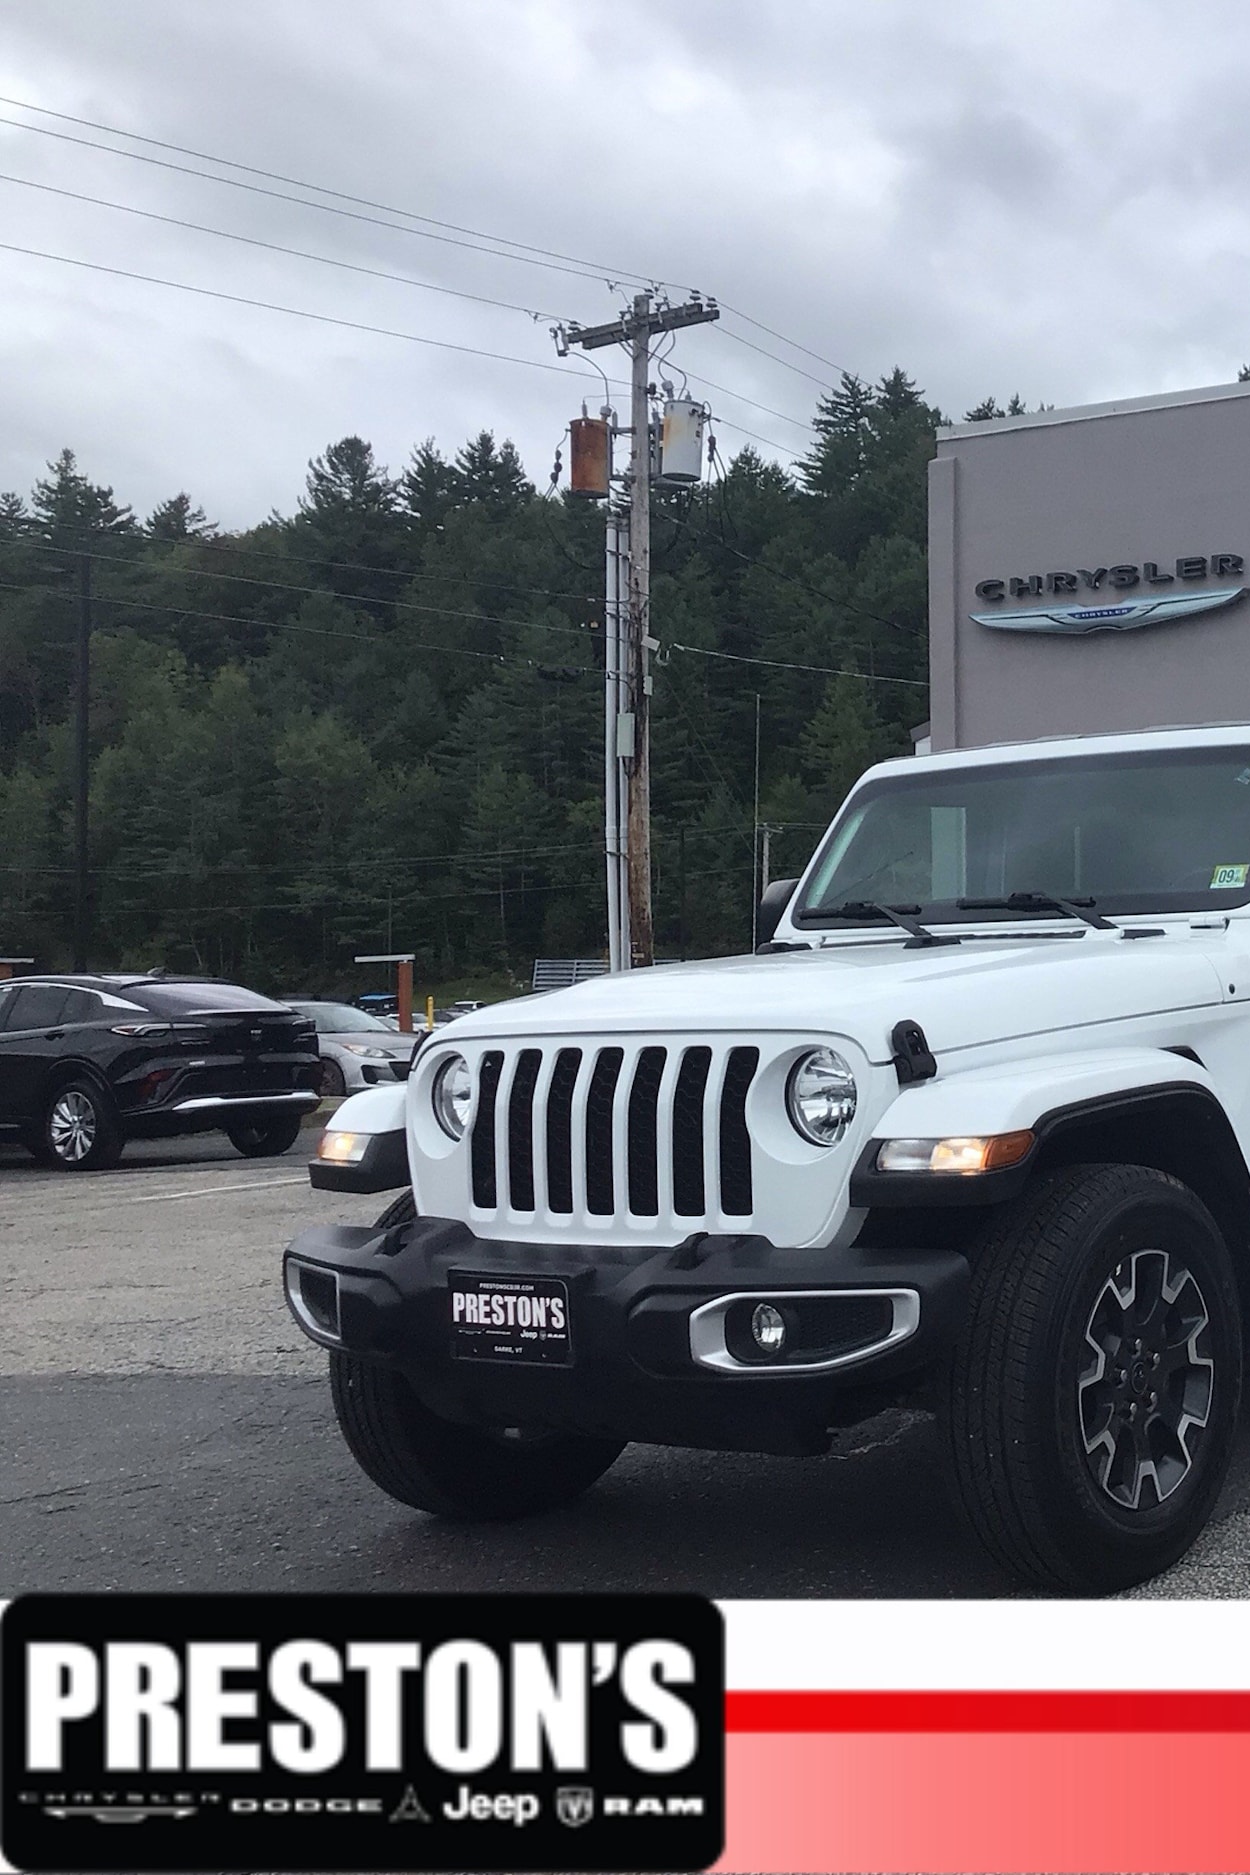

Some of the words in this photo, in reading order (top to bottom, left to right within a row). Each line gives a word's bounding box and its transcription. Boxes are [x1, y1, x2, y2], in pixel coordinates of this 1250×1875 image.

[975, 553, 1245, 600] CHRYSLER
[1074, 609, 1128, 618] CHRYSLER
[1218, 869, 1235, 883] 09
[452, 1292, 566, 1329] PRESTON'S
